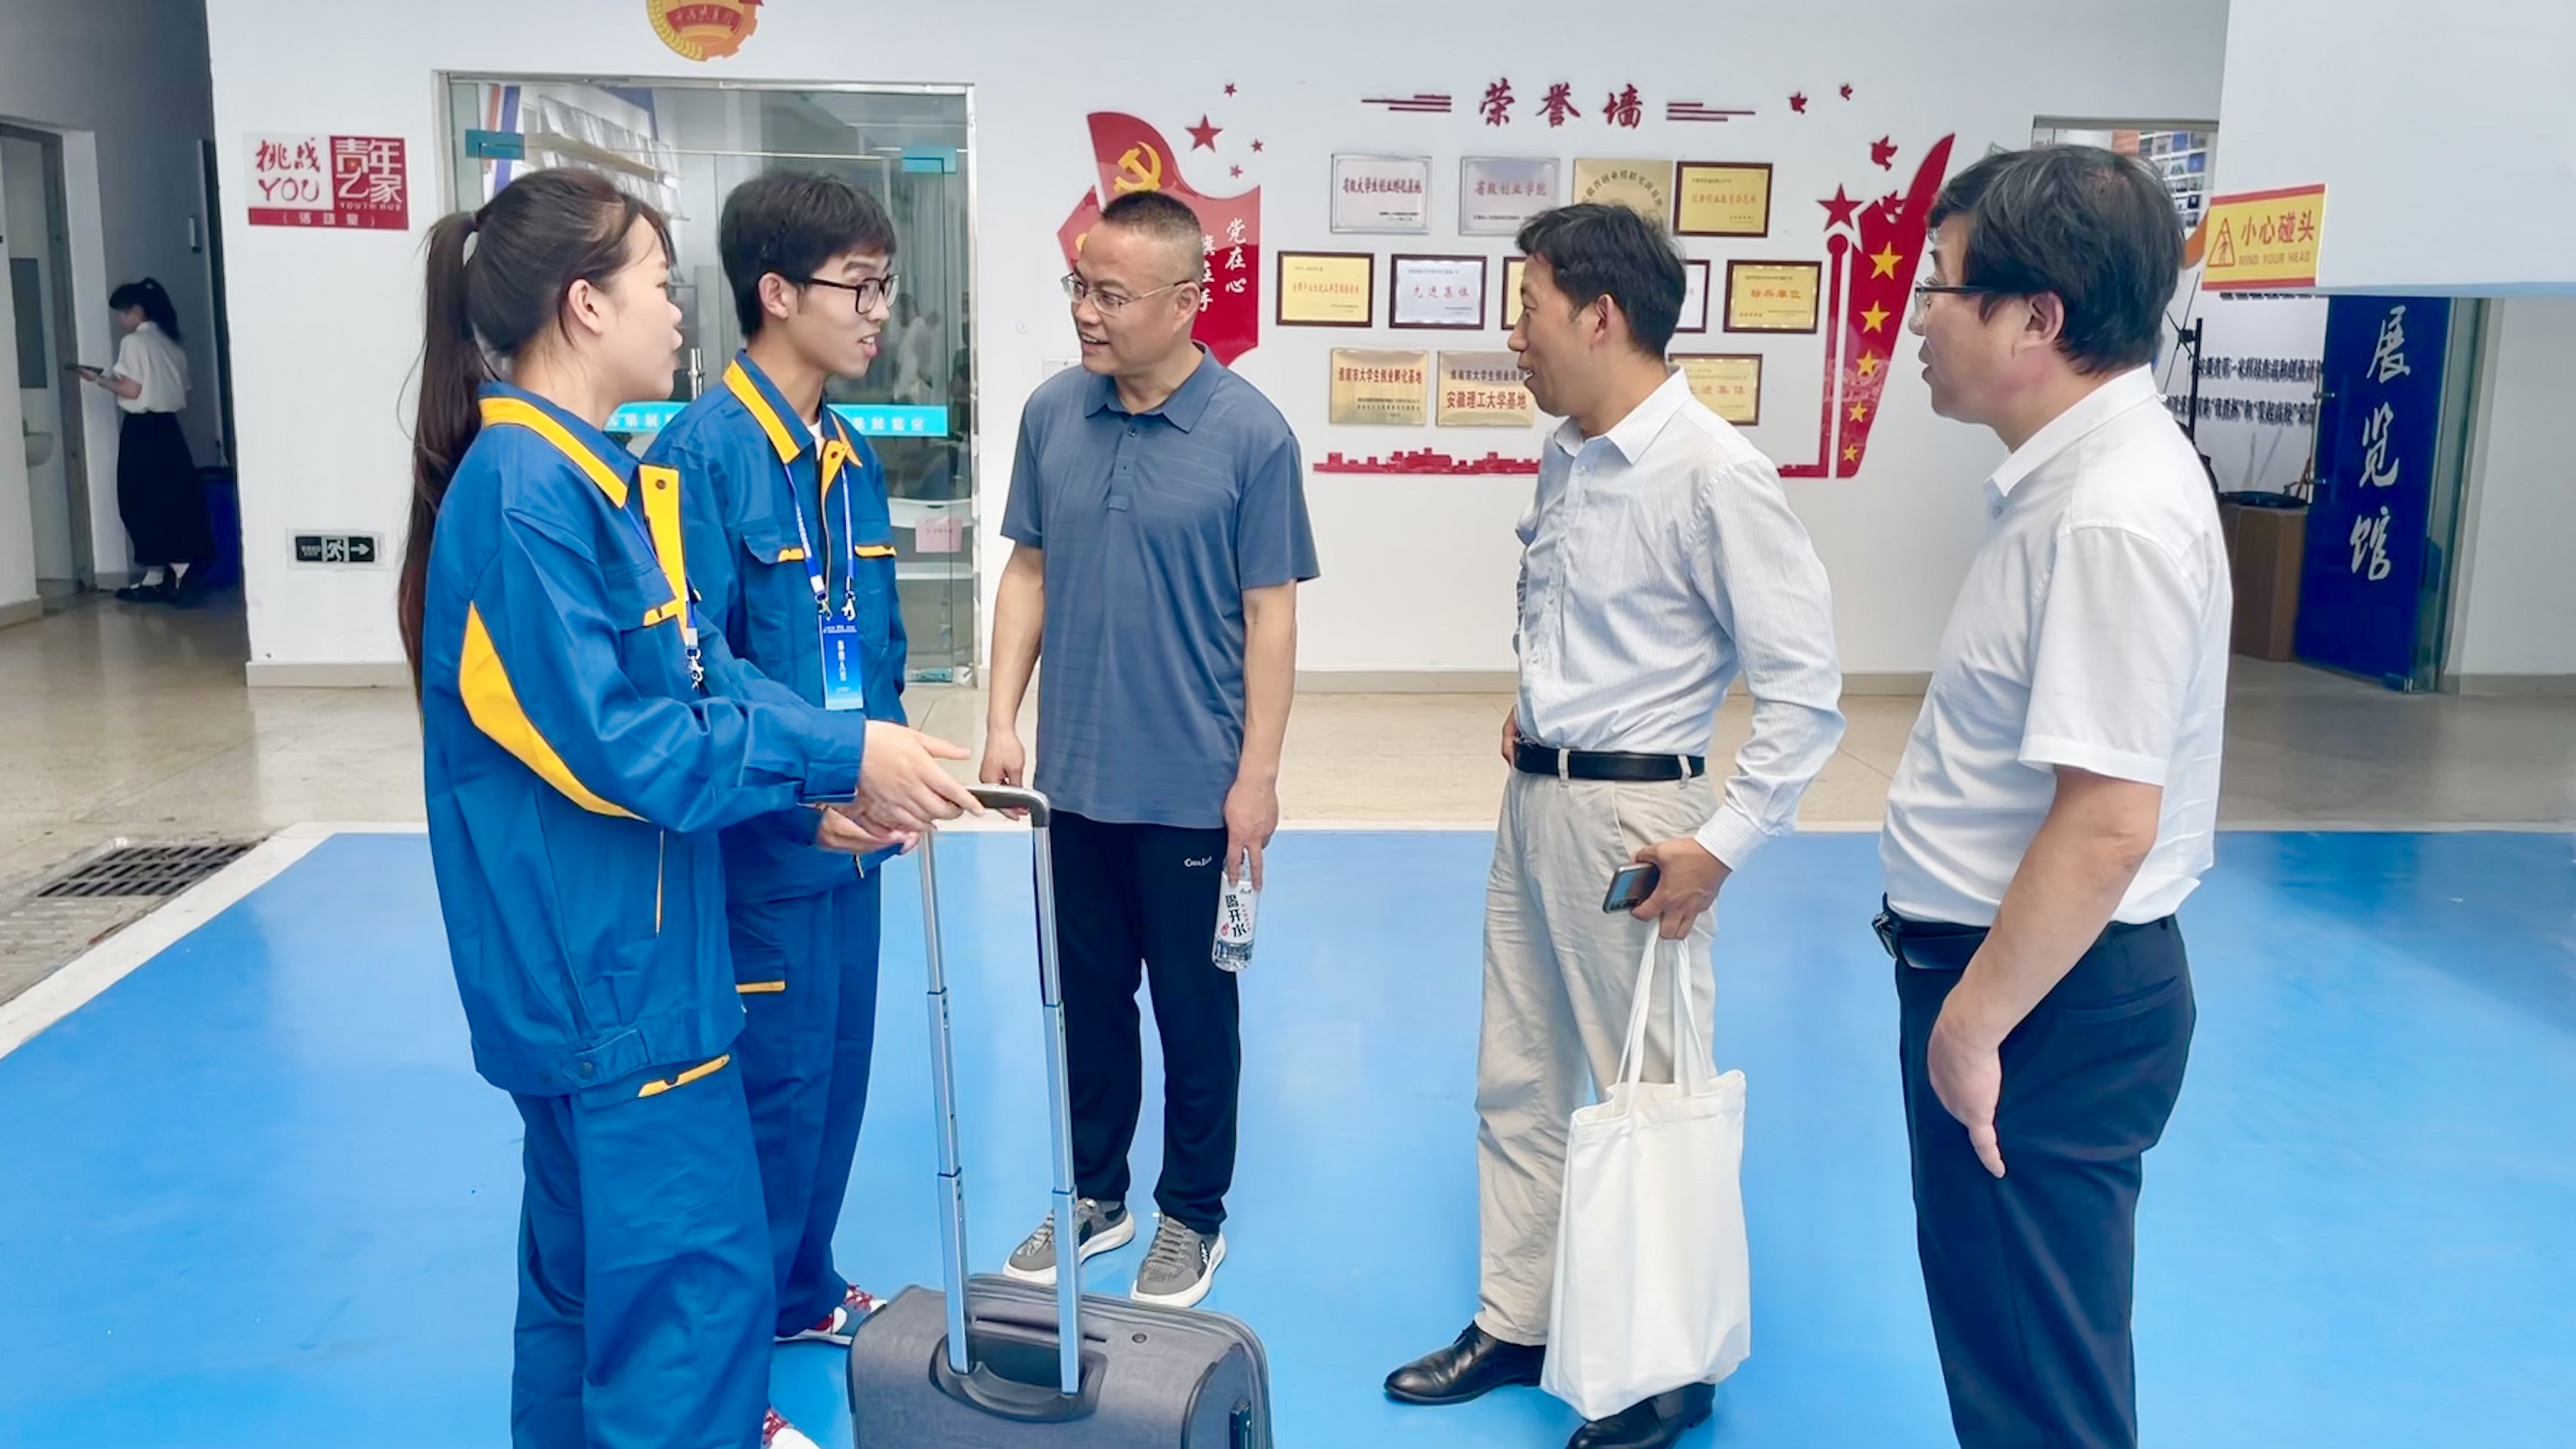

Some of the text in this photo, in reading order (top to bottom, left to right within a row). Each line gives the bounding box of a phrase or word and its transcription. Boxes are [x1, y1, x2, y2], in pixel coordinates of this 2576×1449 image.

[1479, 76, 1643, 129] 荣誉墙
[335, 138, 402, 174] 青年
[258, 177, 320, 203] YOU
[1473, 180, 1547, 197] 省级创业学院
[340, 202, 376, 210] YOUTH
[2240, 210, 2315, 247] 小心碰头
[1224, 217, 1247, 293] 党在心
[2239, 251, 2311, 265] MIND YOUR HEAD
[1413, 285, 1470, 299] 先进集体
[1446, 391, 1527, 410] 安徽理工大学基地
[2350, 305, 2411, 581] 展览馆
